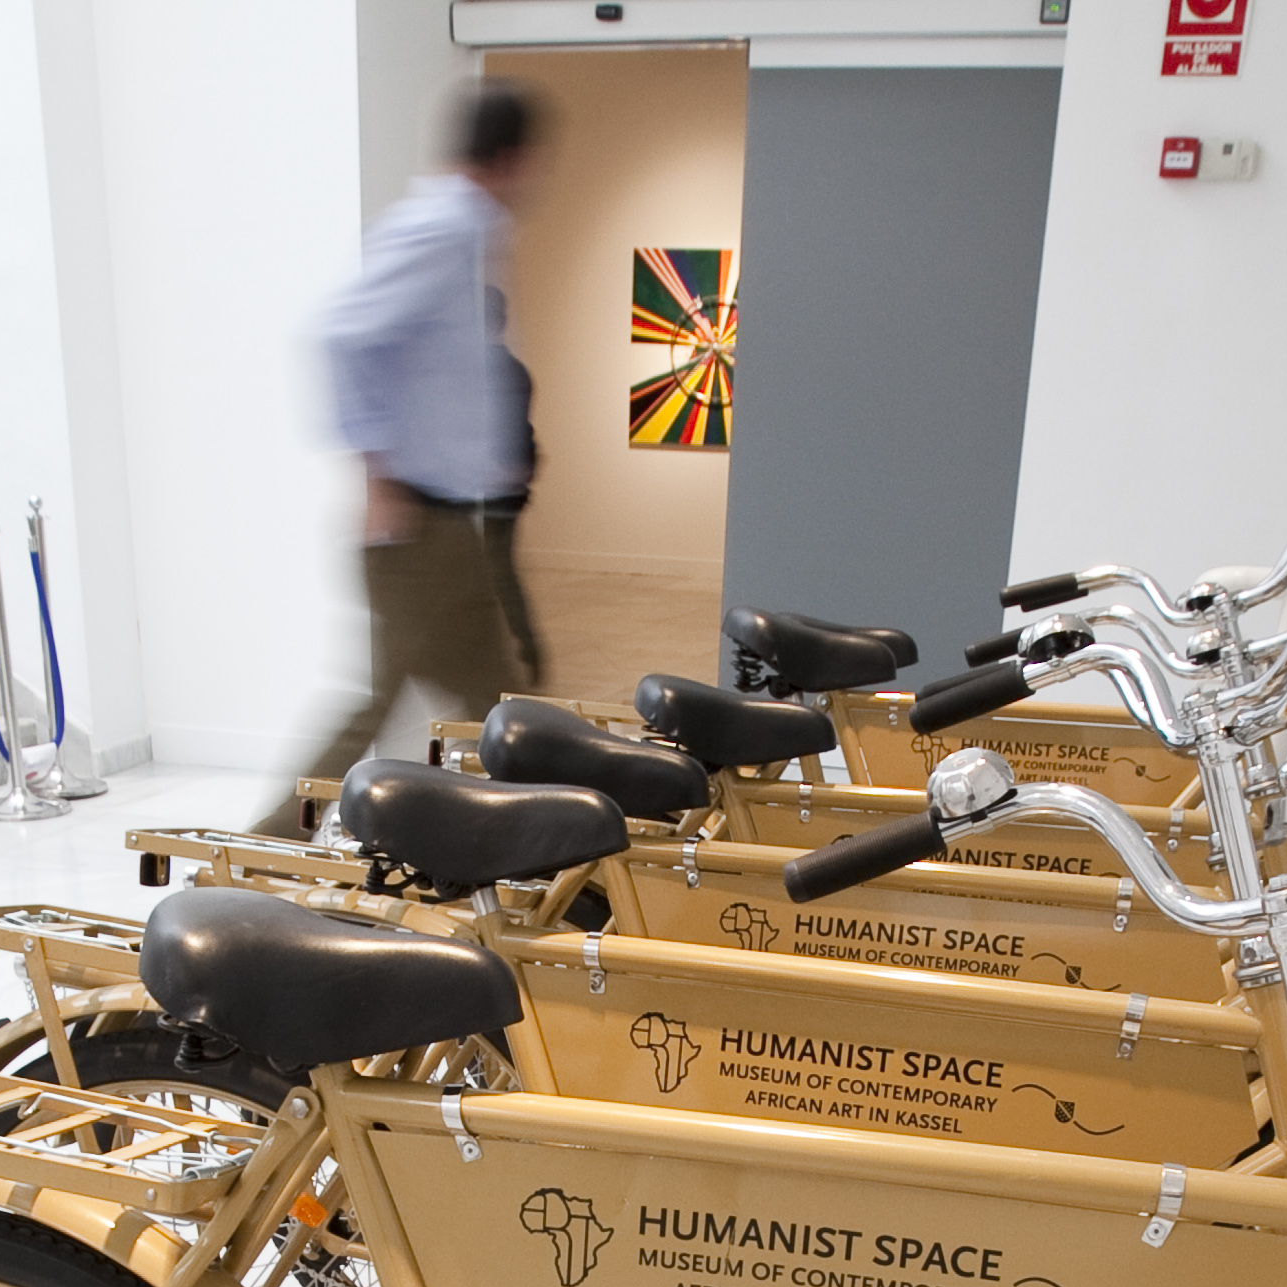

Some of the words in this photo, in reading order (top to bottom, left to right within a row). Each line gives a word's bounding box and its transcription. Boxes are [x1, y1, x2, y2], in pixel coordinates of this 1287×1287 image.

[1172, 42, 1233, 54] PULSADOR
[1193, 53, 1209, 64] DE
[1176, 63, 1223, 75] ALARMA
[1023, 760, 1107, 774] CONTEMPORARY
[1057, 744, 1110, 762] SPACE
[926, 848, 1017, 869] MANIST
[1021, 853, 1092, 875] SPACE
[794, 914, 937, 947] HUMANIST
[943, 929, 1025, 958] SPACE
[794, 941, 861, 960] MUSEUM
[865, 949, 887, 963] OF
[890, 952, 1021, 978] CONTEMPORARY
[720, 1028, 894, 1073] HUMANIST
[901, 1050, 1005, 1089] SPACE
[719, 1061, 801, 1087] MUSEUM
[806, 1072, 833, 1091] OF
[837, 1077, 998, 1114] CONTEMPORARY
[744, 1089, 823, 1115] AFRICAN
[827, 1100, 864, 1119] ART
[868, 1105, 890, 1123] IN
[895, 1110, 963, 1135] KASSEL
[638, 1205, 863, 1262] HUMANIST
[872, 1234, 1003, 1282] SPACE
[638, 1247, 744, 1278] MUSEUM
[751, 1261, 785, 1283] OF
